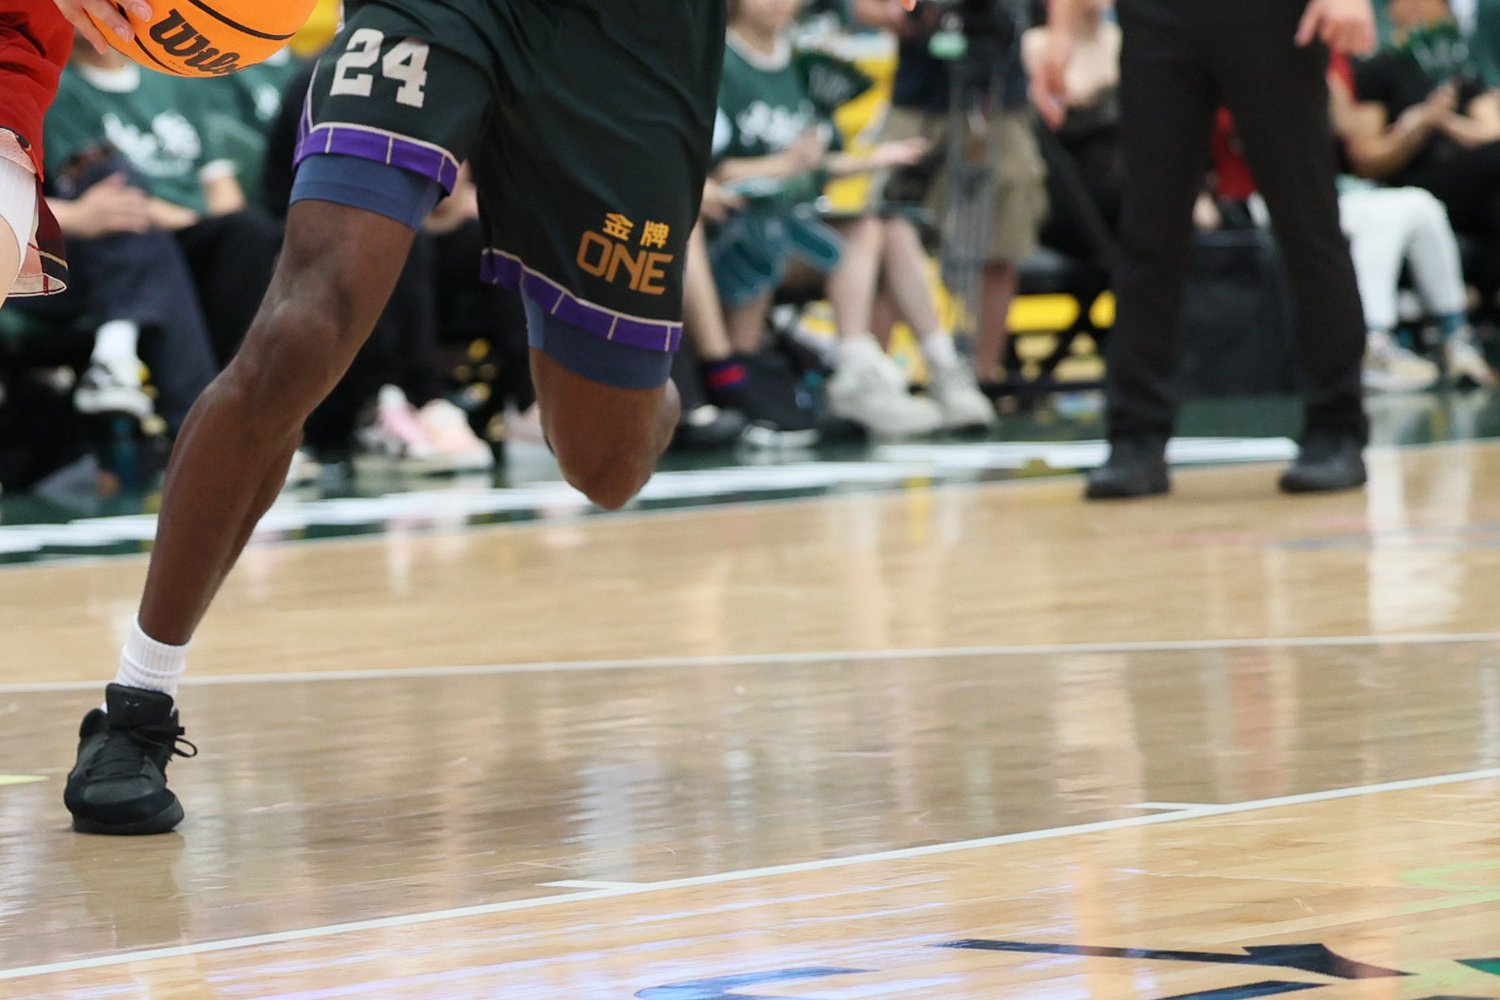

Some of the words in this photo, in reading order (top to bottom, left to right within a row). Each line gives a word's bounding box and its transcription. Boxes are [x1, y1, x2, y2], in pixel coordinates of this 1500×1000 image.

[149, 8, 241, 75] Wil
[330, 28, 430, 108] 24
[576, 231, 674, 295] ONE
[603, 212, 670, 249] 金牌
